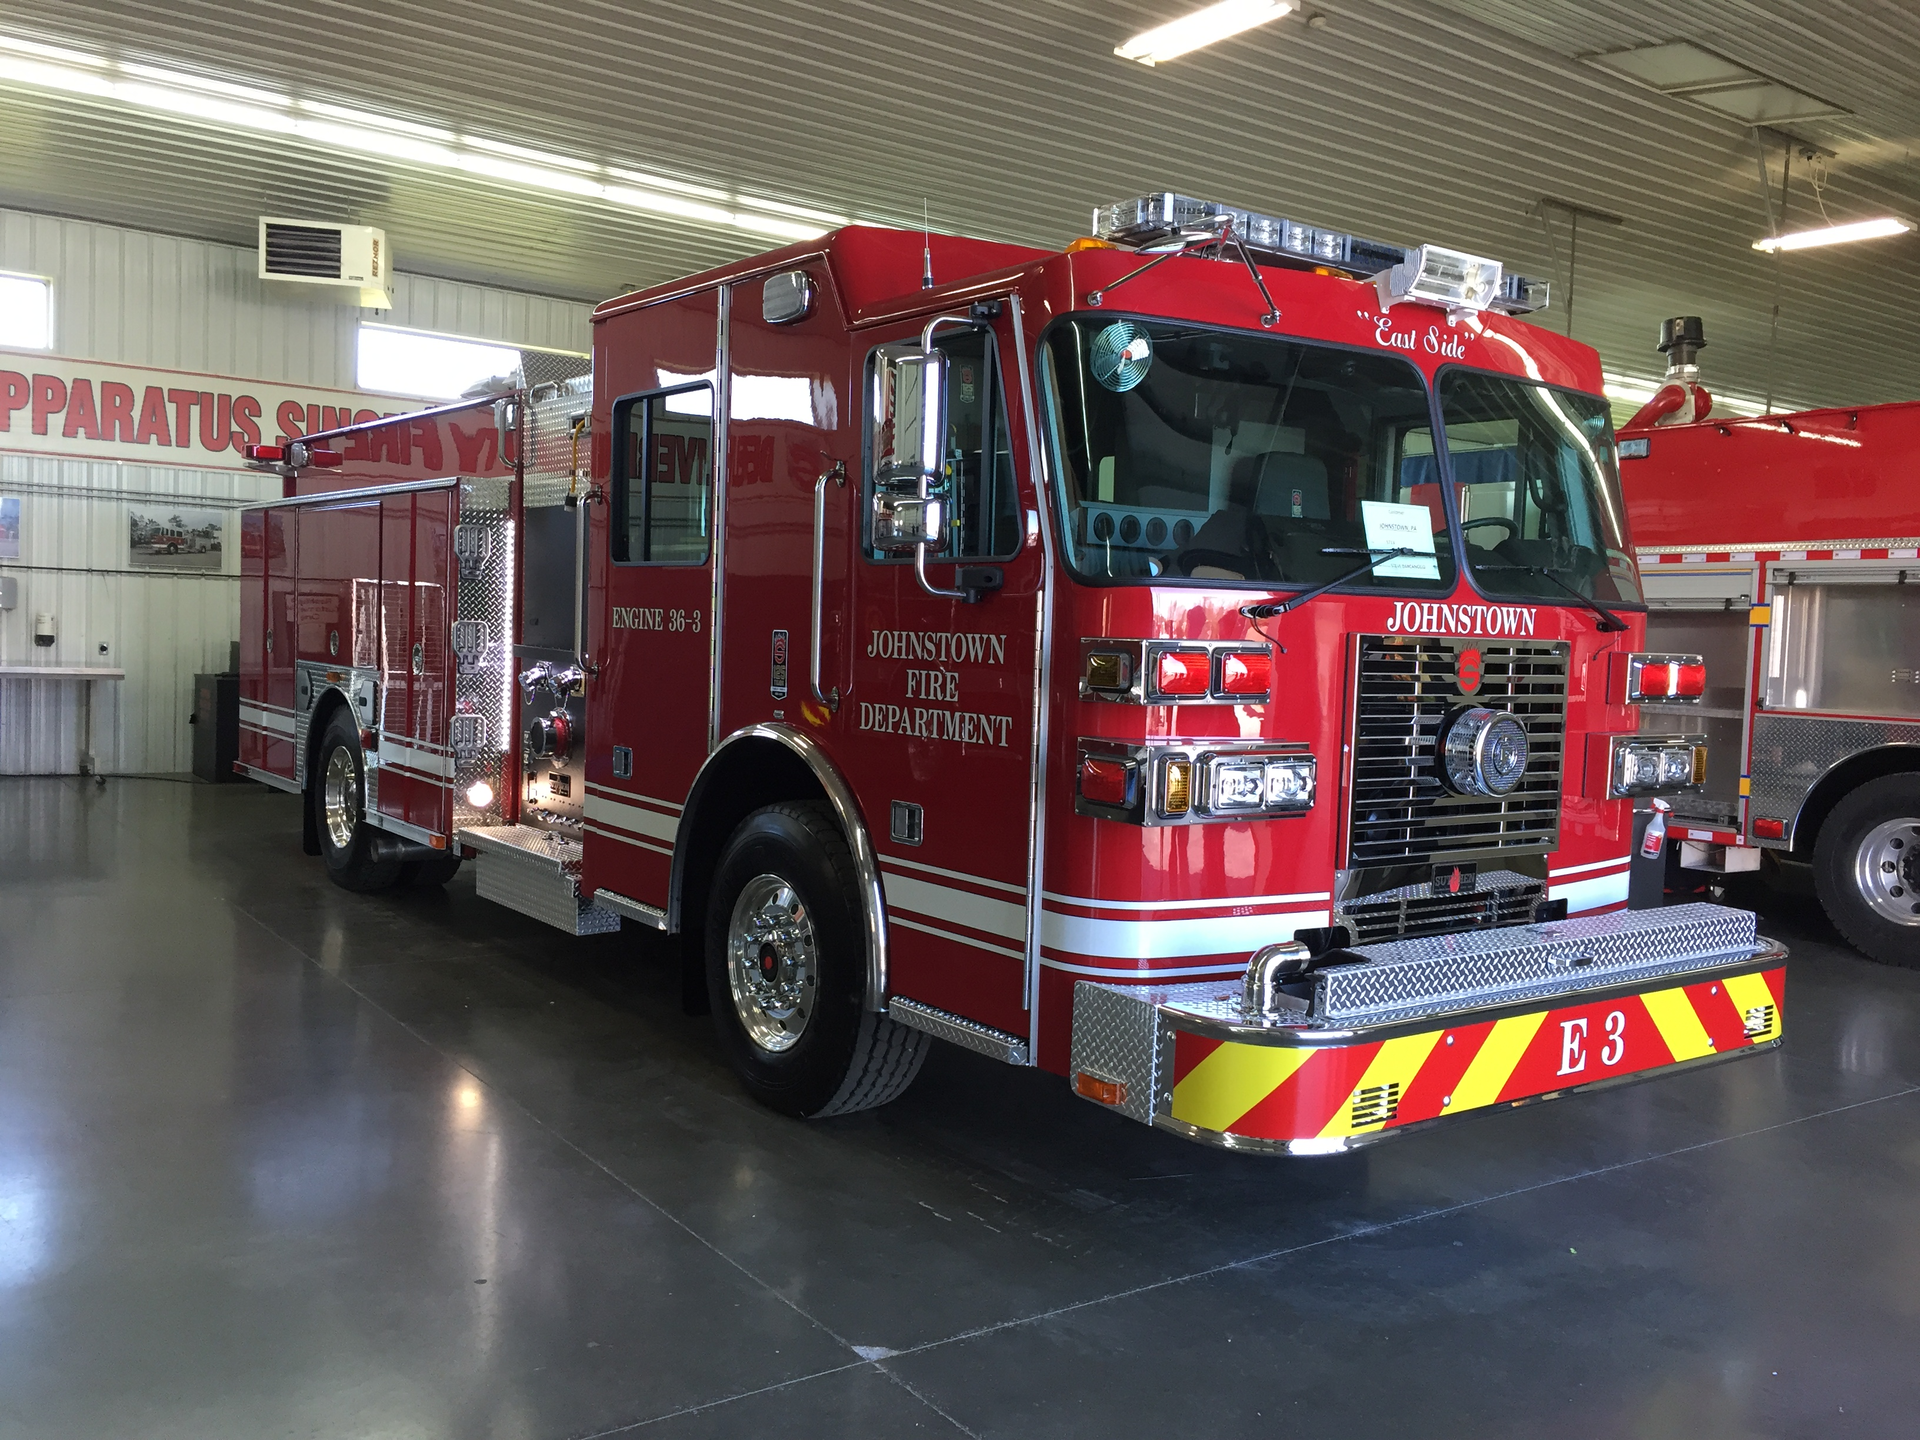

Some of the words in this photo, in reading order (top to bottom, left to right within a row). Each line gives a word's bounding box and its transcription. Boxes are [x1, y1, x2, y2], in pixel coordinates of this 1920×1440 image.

[371, 238, 379, 278] REZNOR
[612, 607, 664, 631] ENGINE
[668, 608, 701, 633] 36-3
[1386, 601, 1537, 636] JOHNSTOWN
[867, 630, 1007, 665] JOHNSTOWN
[905, 669, 959, 702] FIRE
[859, 702, 1013, 747] DEPARTMENT
[1556, 1017, 1588, 1076] E
[1601, 1010, 1626, 1066] 3
